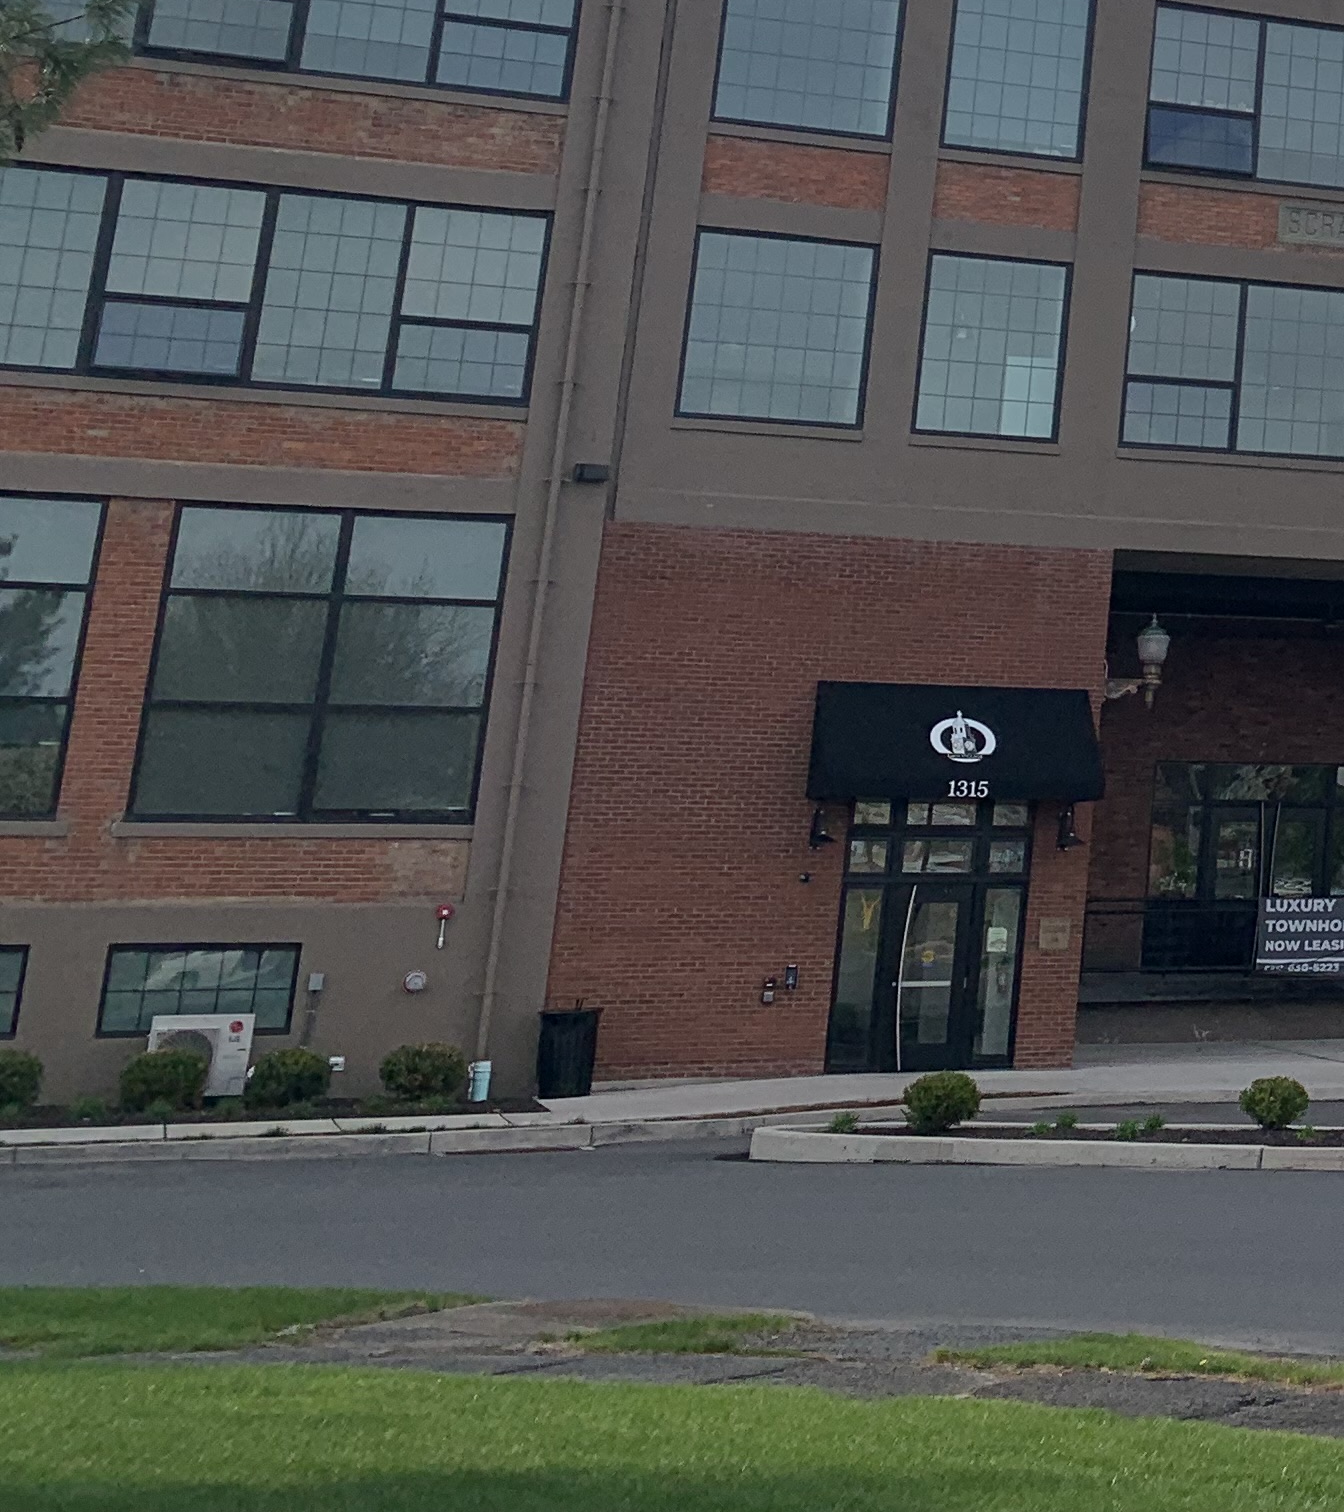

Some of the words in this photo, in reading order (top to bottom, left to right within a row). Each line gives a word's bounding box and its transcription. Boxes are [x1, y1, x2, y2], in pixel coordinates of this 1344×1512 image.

[947, 779, 989, 798] 1315
[1265, 898, 1336, 913] LUXURY
[1265, 940, 1300, 952] NOW
